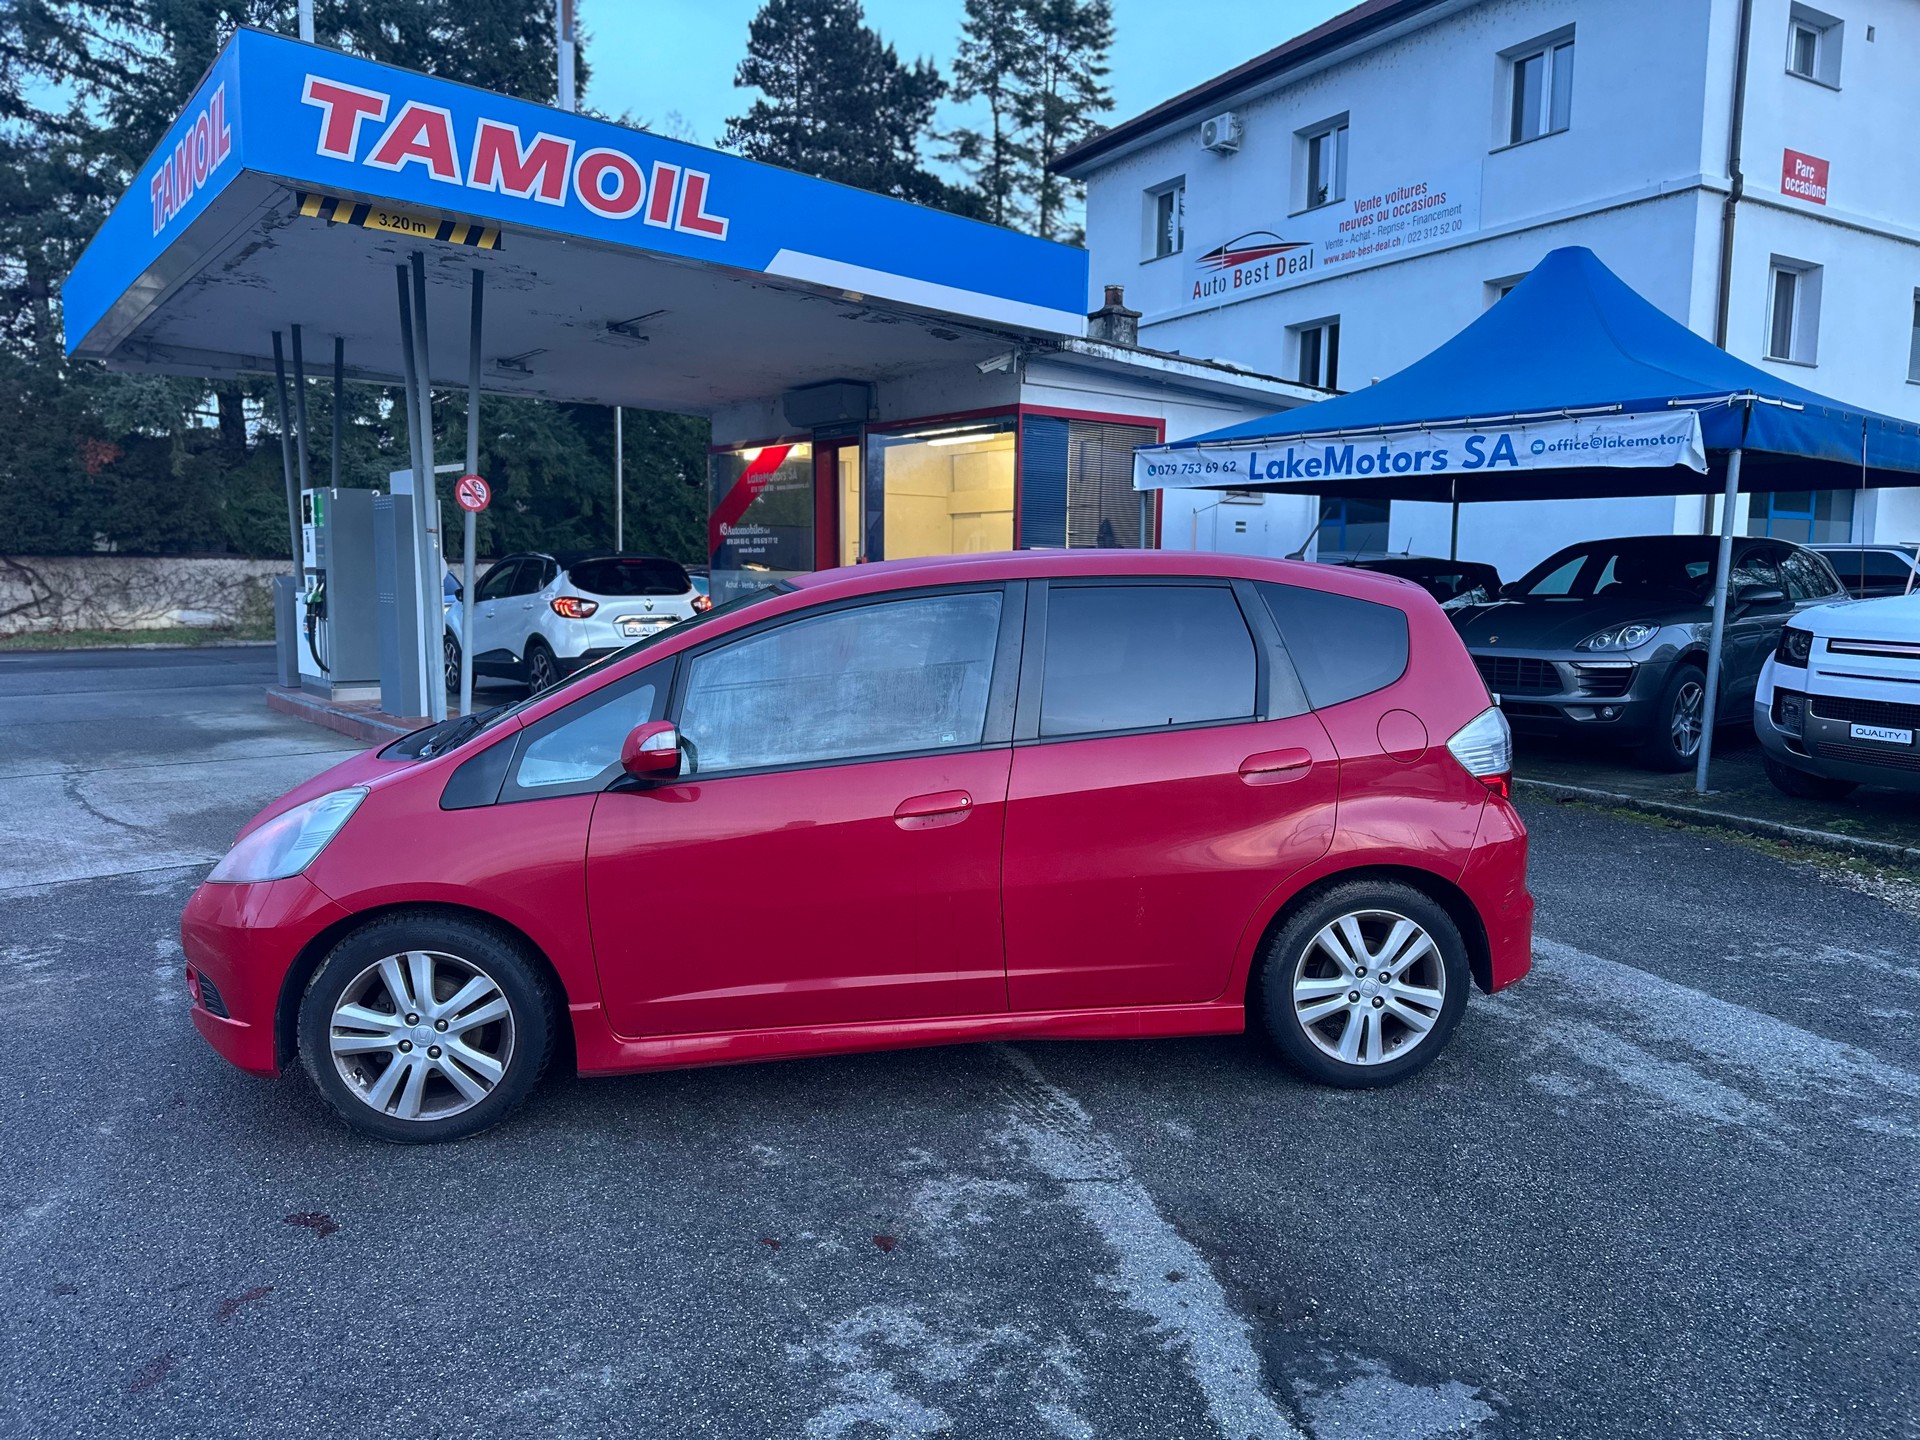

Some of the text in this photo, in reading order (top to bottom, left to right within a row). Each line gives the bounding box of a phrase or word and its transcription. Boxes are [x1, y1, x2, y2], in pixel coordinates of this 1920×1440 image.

[151, 80, 231, 239] TAMOIL
[301, 74, 730, 241] TAMOIL
[1795, 159, 1815, 179] Parc
[1354, 182, 1428, 214] Vente voitures
[1785, 177, 1826, 200] occasions
[379, 213, 426, 233] 3.20 m
[1325, 238, 1343, 250] Vente
[1350, 230, 1371, 244] Achat
[1377, 221, 1405, 237] Reprise
[1412, 204, 1462, 227] Financement
[1339, 192, 1447, 233] neuves ou occasions
[1323, 237, 1400, 265] www.auto-best-deal.ch
[1408, 230, 1421, 244] 022
[1424, 226, 1438, 239] 312
[1440, 222, 1450, 235] 52
[1452, 219, 1462, 231] 00
[1192, 248, 1314, 300] Auto Best Deal
[1157, 464, 1177, 476] 079
[1181, 463, 1202, 475] 753
[1205, 462, 1219, 473] 69
[1222, 461, 1237, 473] 62
[1250, 444, 1448, 480] LakeMotors
[1462, 433, 1519, 469] SA
[746, 468, 798, 484] LakeMotors SA
[331, 488, 338, 500] 1
[728, 523, 763, 535] Automobiles
[1855, 727, 1901, 740] QUALITY
